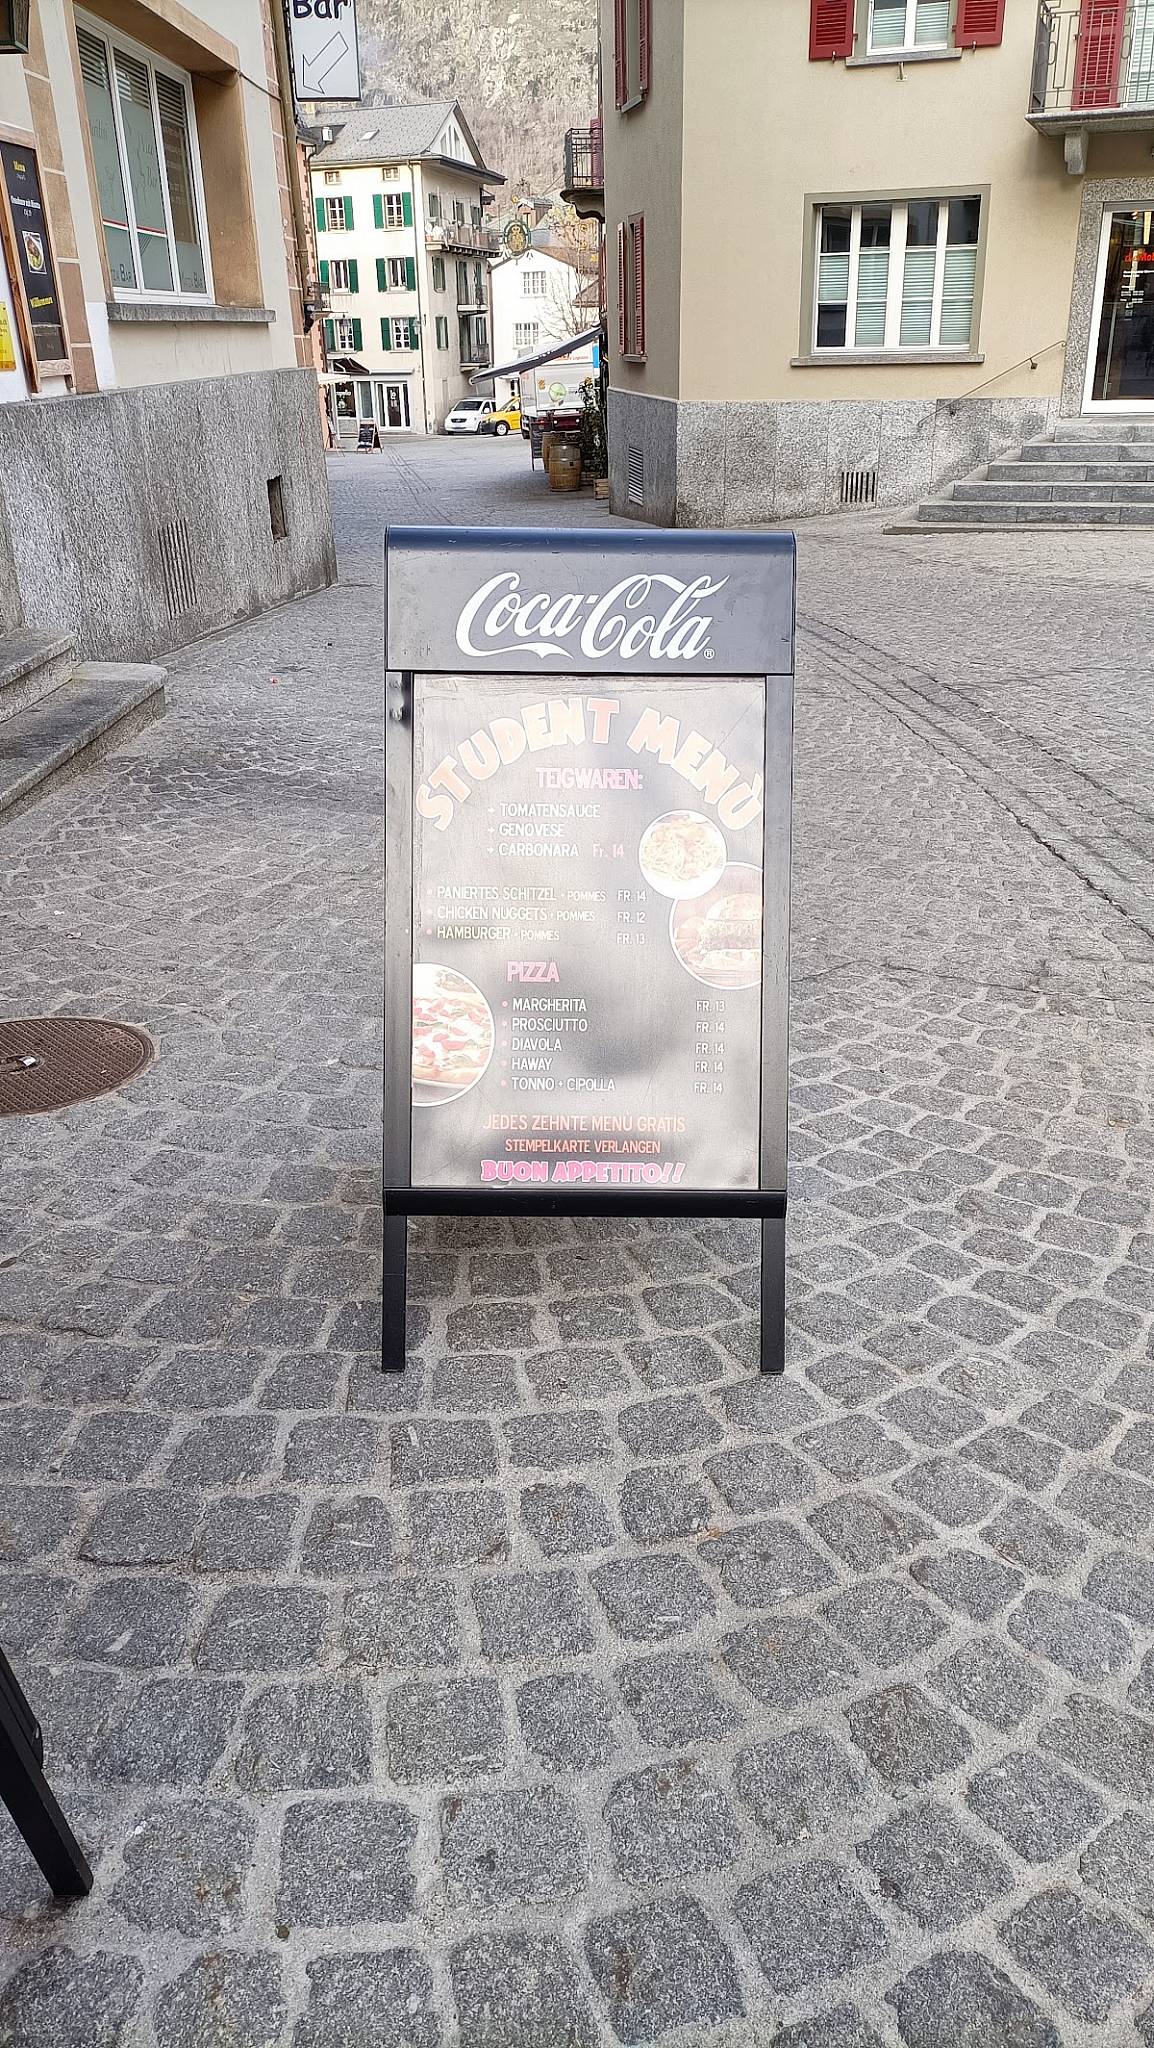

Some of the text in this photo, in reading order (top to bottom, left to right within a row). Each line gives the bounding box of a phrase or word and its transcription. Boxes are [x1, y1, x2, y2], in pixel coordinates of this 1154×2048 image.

[455, 571, 731, 660] Coca-Cola
[416, 697, 620, 832] STUDENT
[535, 767, 644, 790] TEIGWAREN:
[499, 803, 601, 818] TOMATENSAUCE
[498, 822, 565, 837] GENOVESE
[498, 842, 580, 857] CARBONARA
[612, 844, 625, 858] 14
[437, 885, 499, 900] PANIERTES
[502, 886, 557, 901] SCHITZEL
[567, 890, 606, 902] POMMES
[617, 889, 633, 901] FR.
[636, 890, 647, 902] 14
[437, 905, 489, 920] CHICKEN
[491, 906, 548, 921] NUGGETS
[556, 910, 596, 921] POMMES
[617, 911, 633, 923] FR.
[636, 911, 646, 923] 12
[437, 925, 511, 939] HAMBURGER
[521, 930, 560, 941] POMMES
[616, 932, 633, 945] FR.
[636, 933, 646, 945] 13
[507, 960, 560, 983] PIZZA
[512, 998, 725, 1012] MARGHERITA FR. 13
[511, 1017, 725, 1033] PROSCIUTTO FR. 14
[511, 1037, 725, 1054] DIAVOLA FR. 14
[511, 1057, 723, 1073] HAWAY FR. 14
[511, 1076, 555, 1090] TONNO
[566, 1078, 615, 1091] CIPOLLA
[693, 1082, 709, 1094] FR.
[713, 1082, 723, 1094] 14
[483, 1114, 528, 1130] JEDES
[532, 1114, 588, 1131] ZEHNTE
[637, 1116, 686, 1133] GRATIS
[505, 1138, 661, 1154] STEMPELKARTE VERLANGEN
[480, 1159, 686, 1184] BUON APPETITO!!
